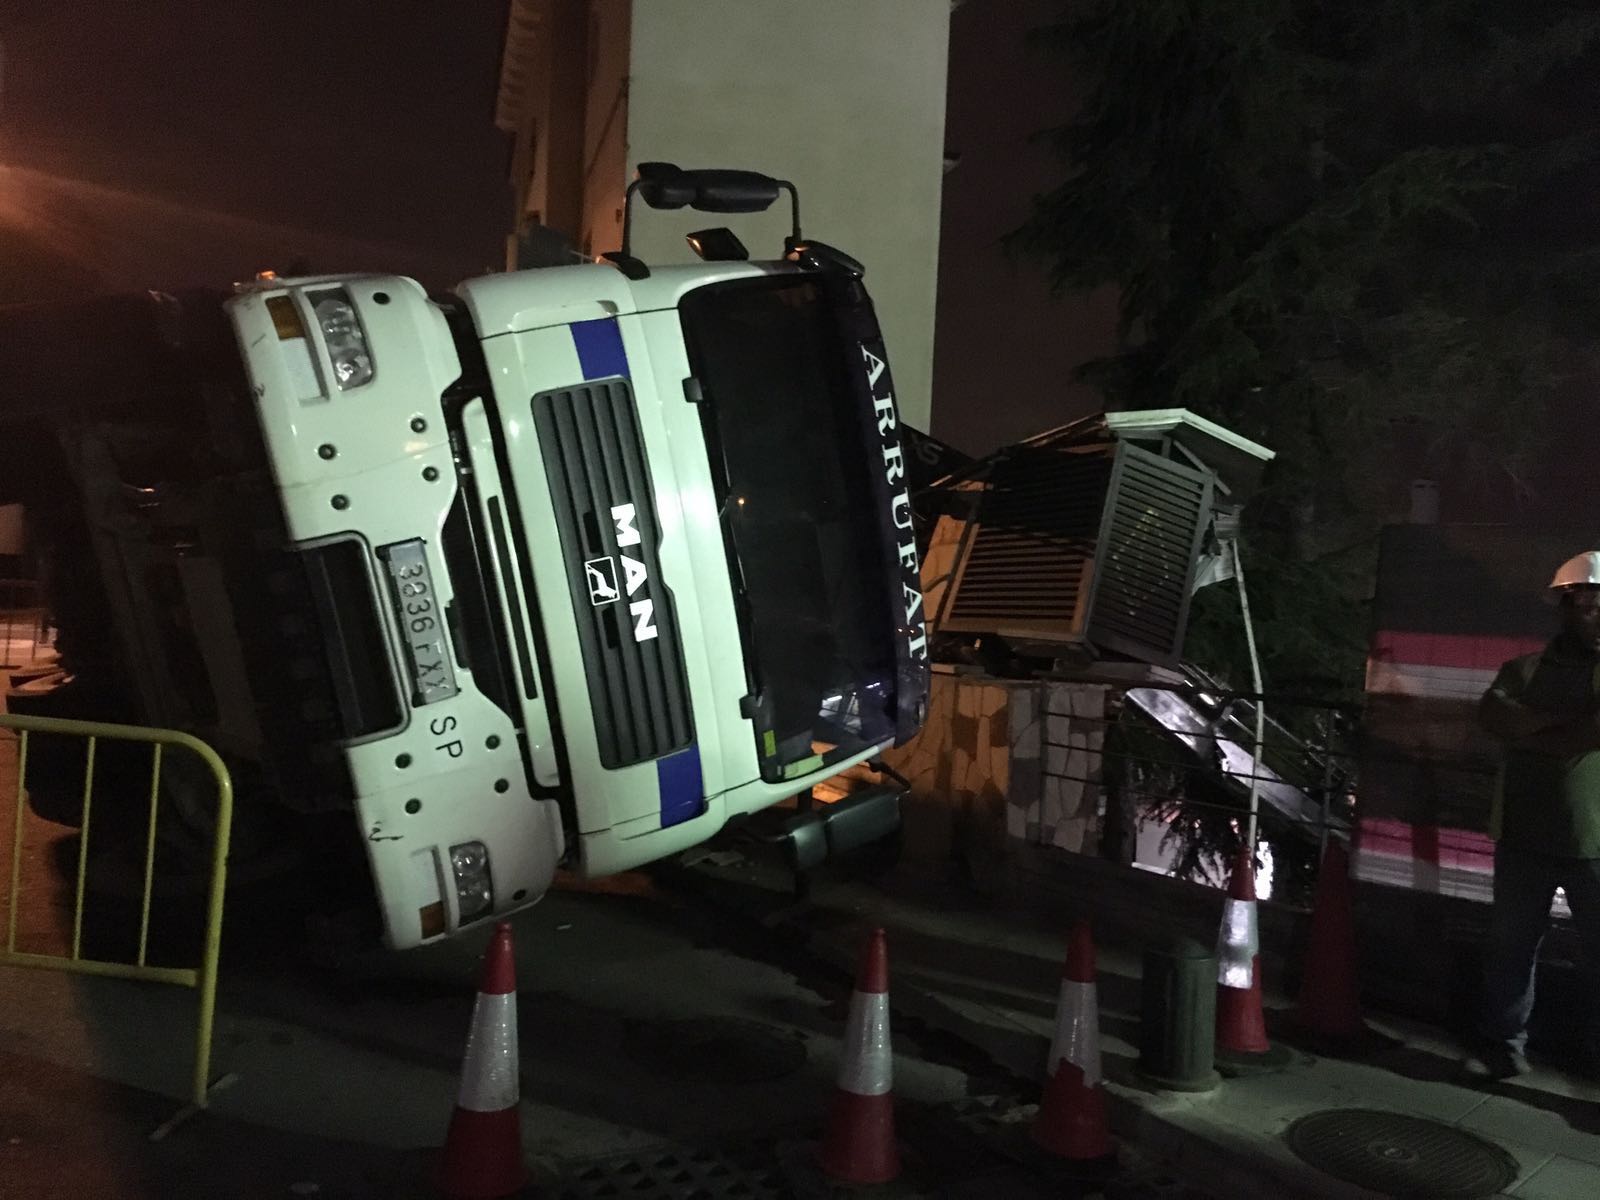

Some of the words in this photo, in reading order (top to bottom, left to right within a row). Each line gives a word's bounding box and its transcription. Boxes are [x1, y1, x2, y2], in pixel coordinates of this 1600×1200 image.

[861, 344, 928, 661] ARRUFAT
[399, 562, 435, 634] 3836
[610, 503, 658, 642] MAN
